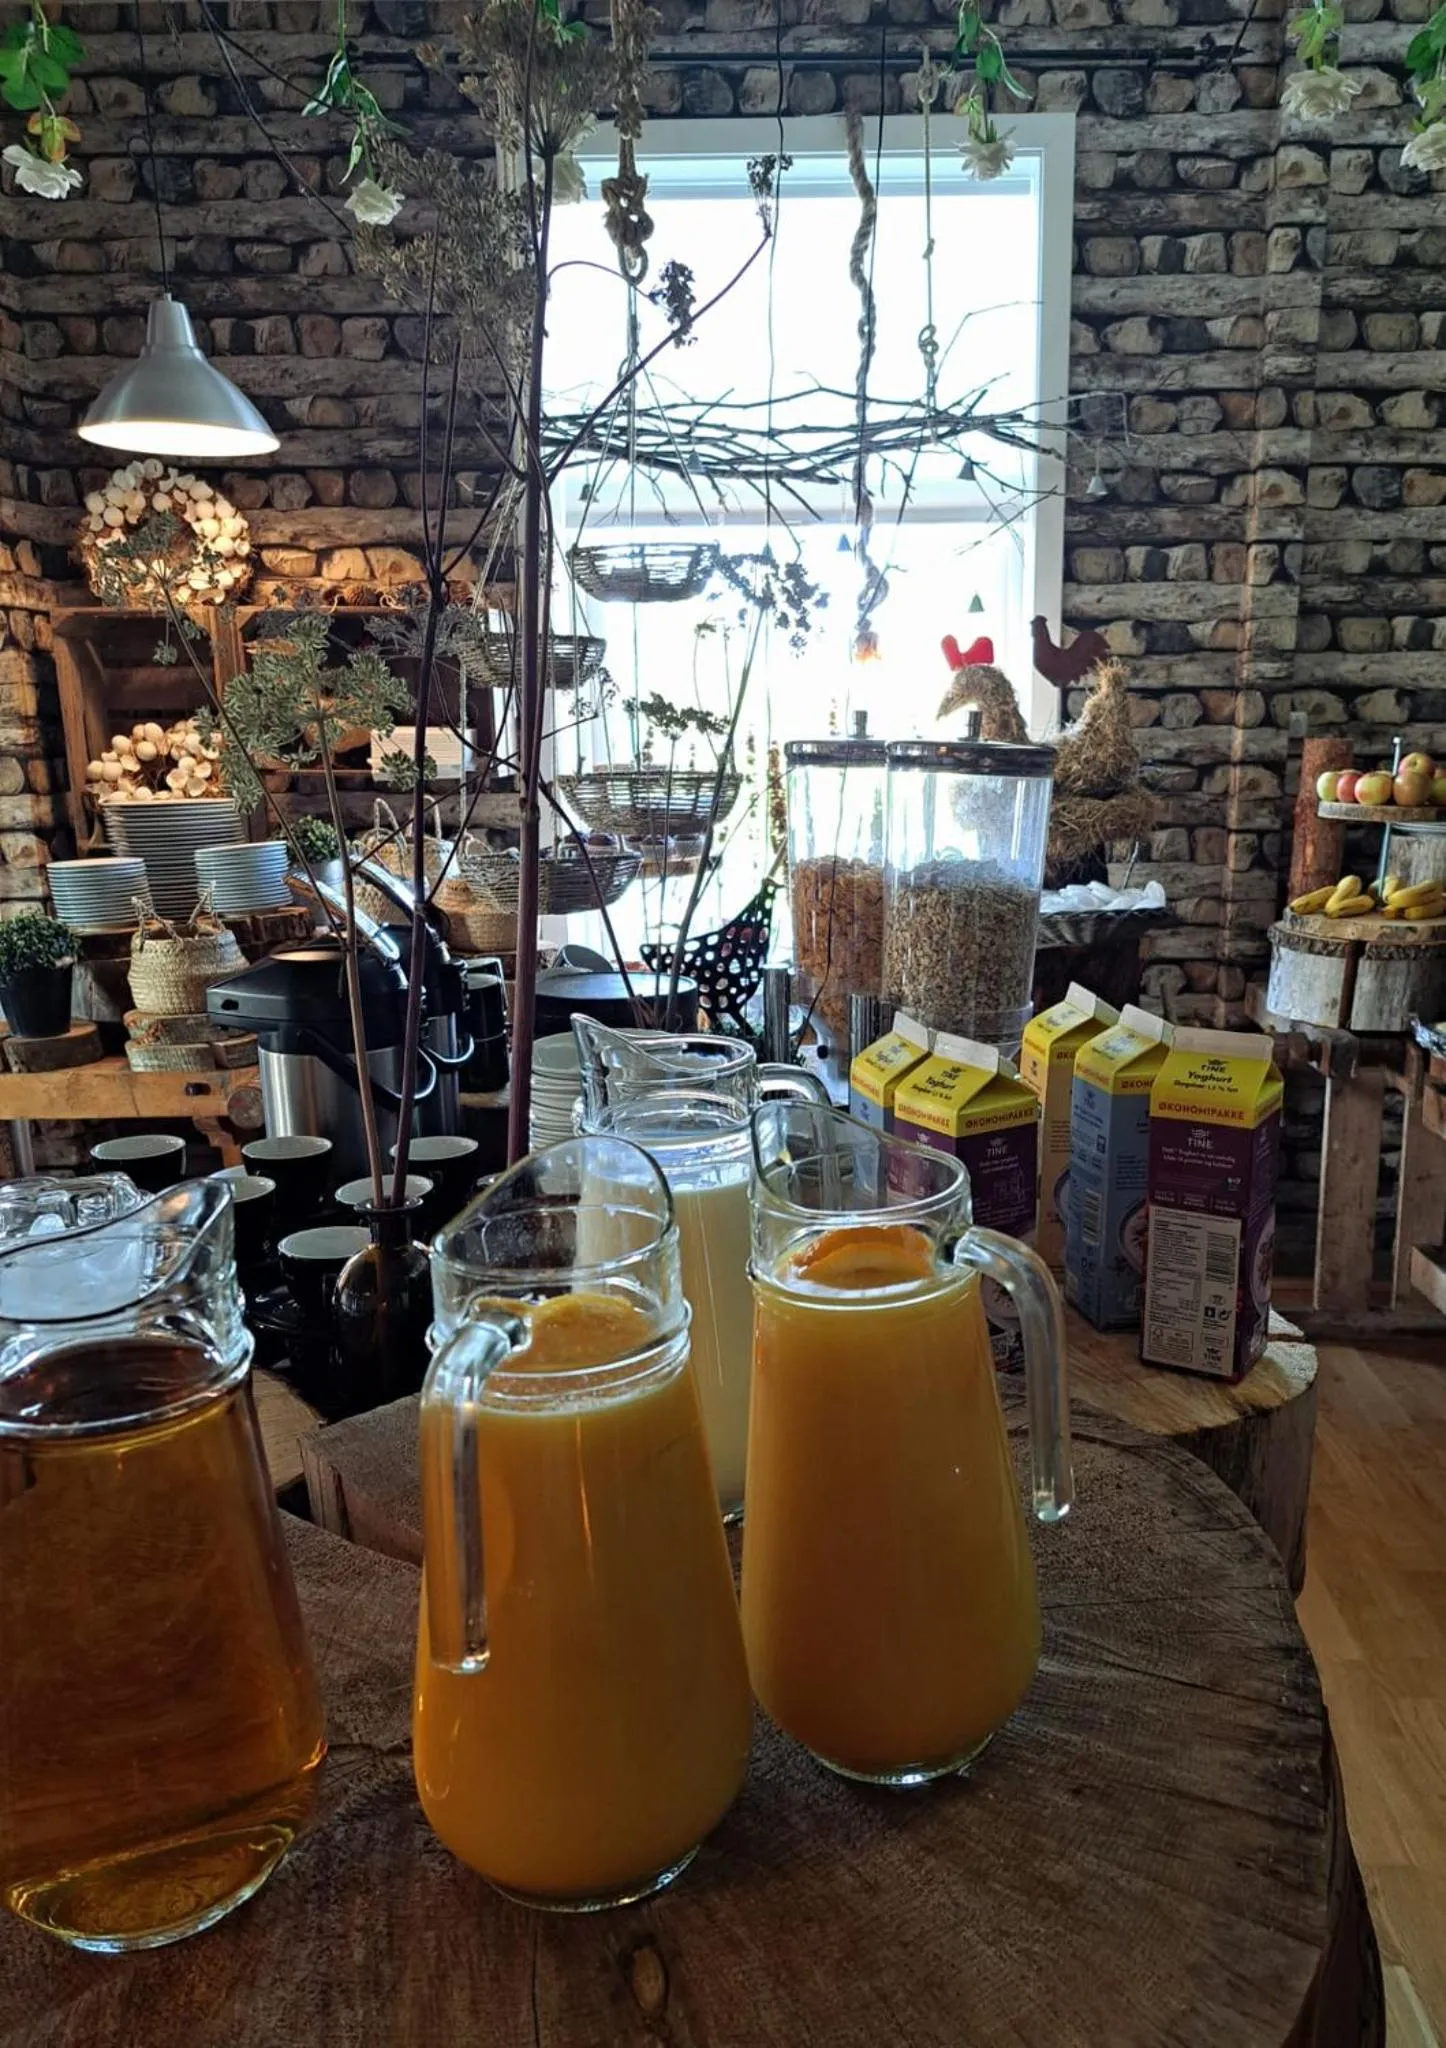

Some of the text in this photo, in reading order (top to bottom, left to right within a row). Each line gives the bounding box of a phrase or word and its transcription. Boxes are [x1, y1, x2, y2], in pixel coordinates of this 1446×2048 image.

[1201, 1063, 1227, 1073] TINE
[1187, 1071, 1233, 1083] Yoghurt
[1158, 1102, 1245, 1120] ØKONOMIPAKKE
[964, 1107, 1034, 1129] ØKONOMIPAKKE
[1187, 1137, 1214, 1150] TINE
[986, 1145, 1008, 1157] TINE
